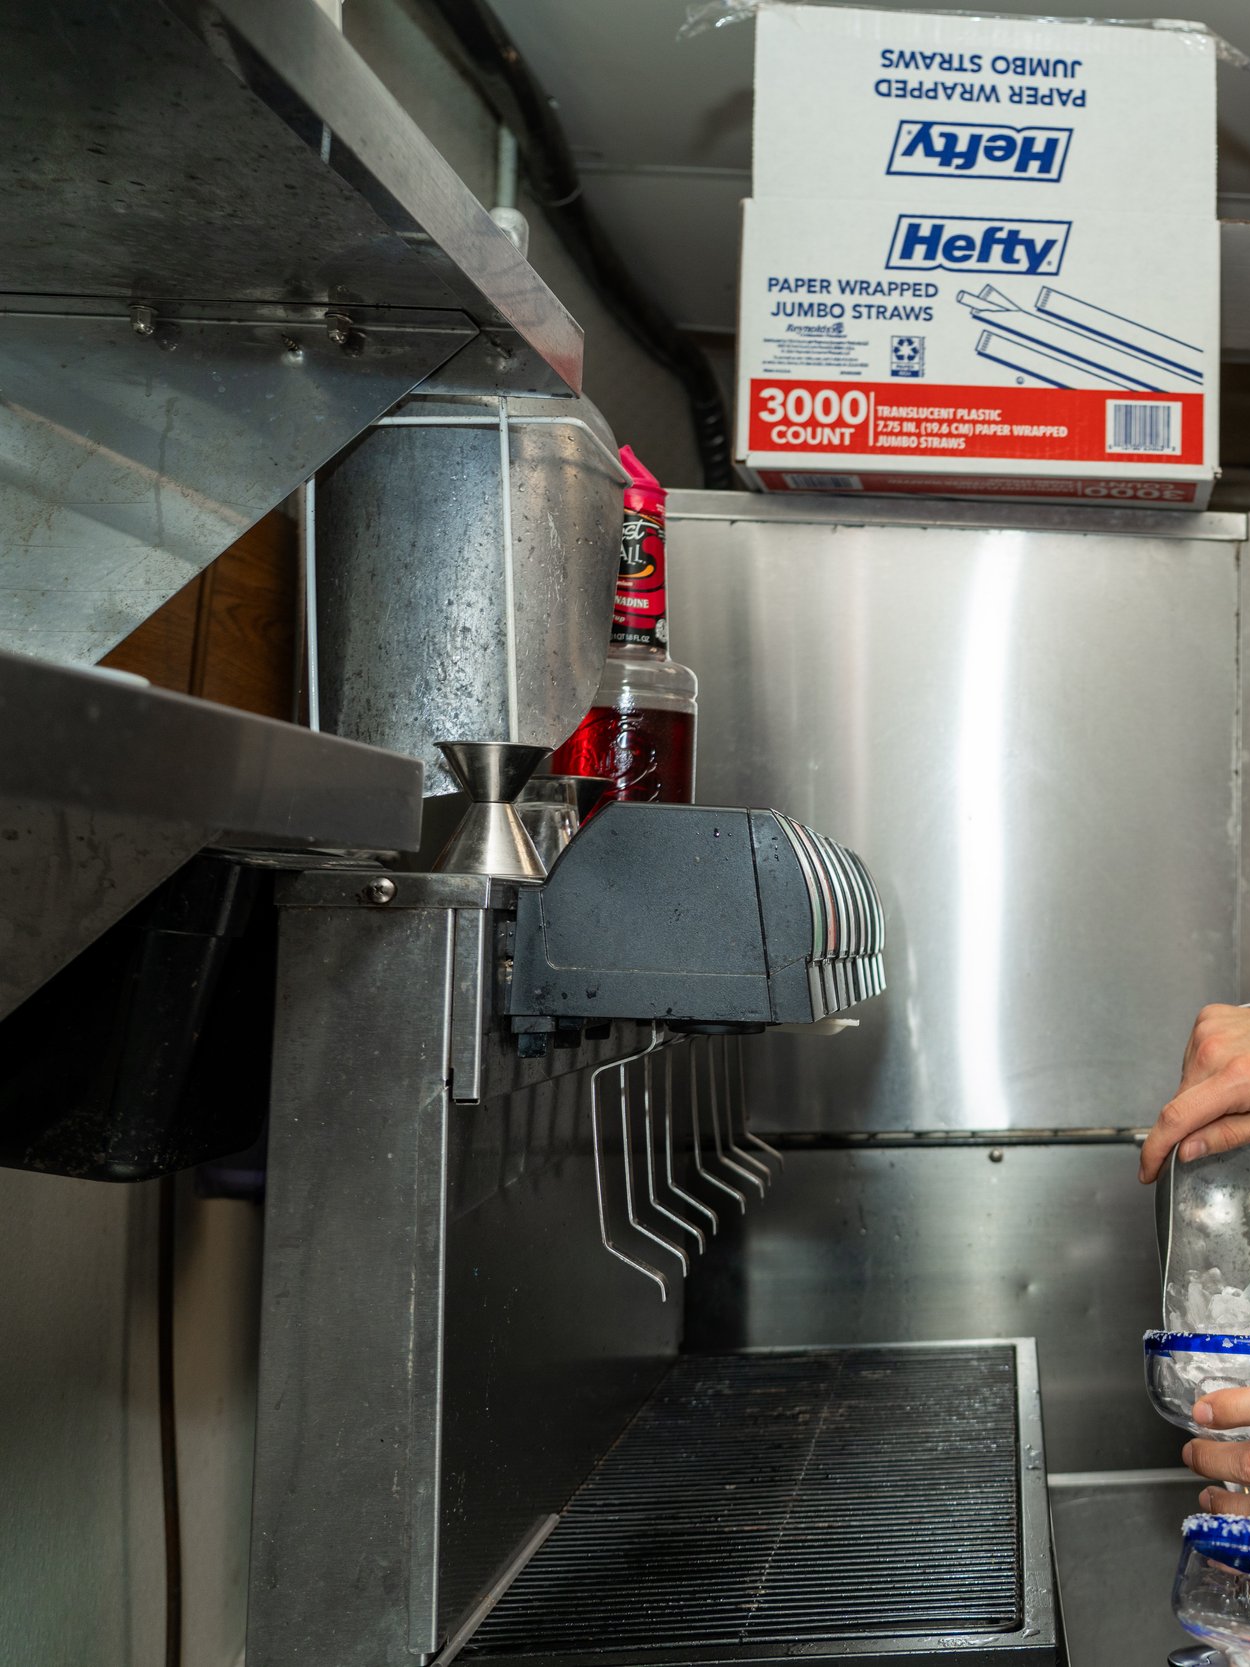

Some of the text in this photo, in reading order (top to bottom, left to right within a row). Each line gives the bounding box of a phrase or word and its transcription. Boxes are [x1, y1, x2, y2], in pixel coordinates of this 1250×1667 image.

[880, 48, 1084, 80] JUMBO STRAWS
[873, 78, 1088, 108] PAPER WRAPPED
[901, 121, 1061, 175] Hefty
[899, 220, 1060, 274] Hefty
[767, 277, 940, 298] PAPER WRAPPED
[770, 301, 934, 322] JUMBO STRAWS
[758, 387, 869, 425] 3000
[876, 405, 1002, 421] TRANSLUCENT PLASTIC
[770, 425, 856, 446] COUNT
[876, 420, 901, 433] 7.75
[920, 422, 950, 436] (19.6
[950, 423, 973, 437] CM)
[974, 424, 1011, 436] PAPER
[1012, 425, 1069, 438] WRAPPED
[875, 435, 966, 449] JUMBO STRAWS
[1083, 485, 1186, 500] 3000
[614, 595, 650, 609] NADINE
